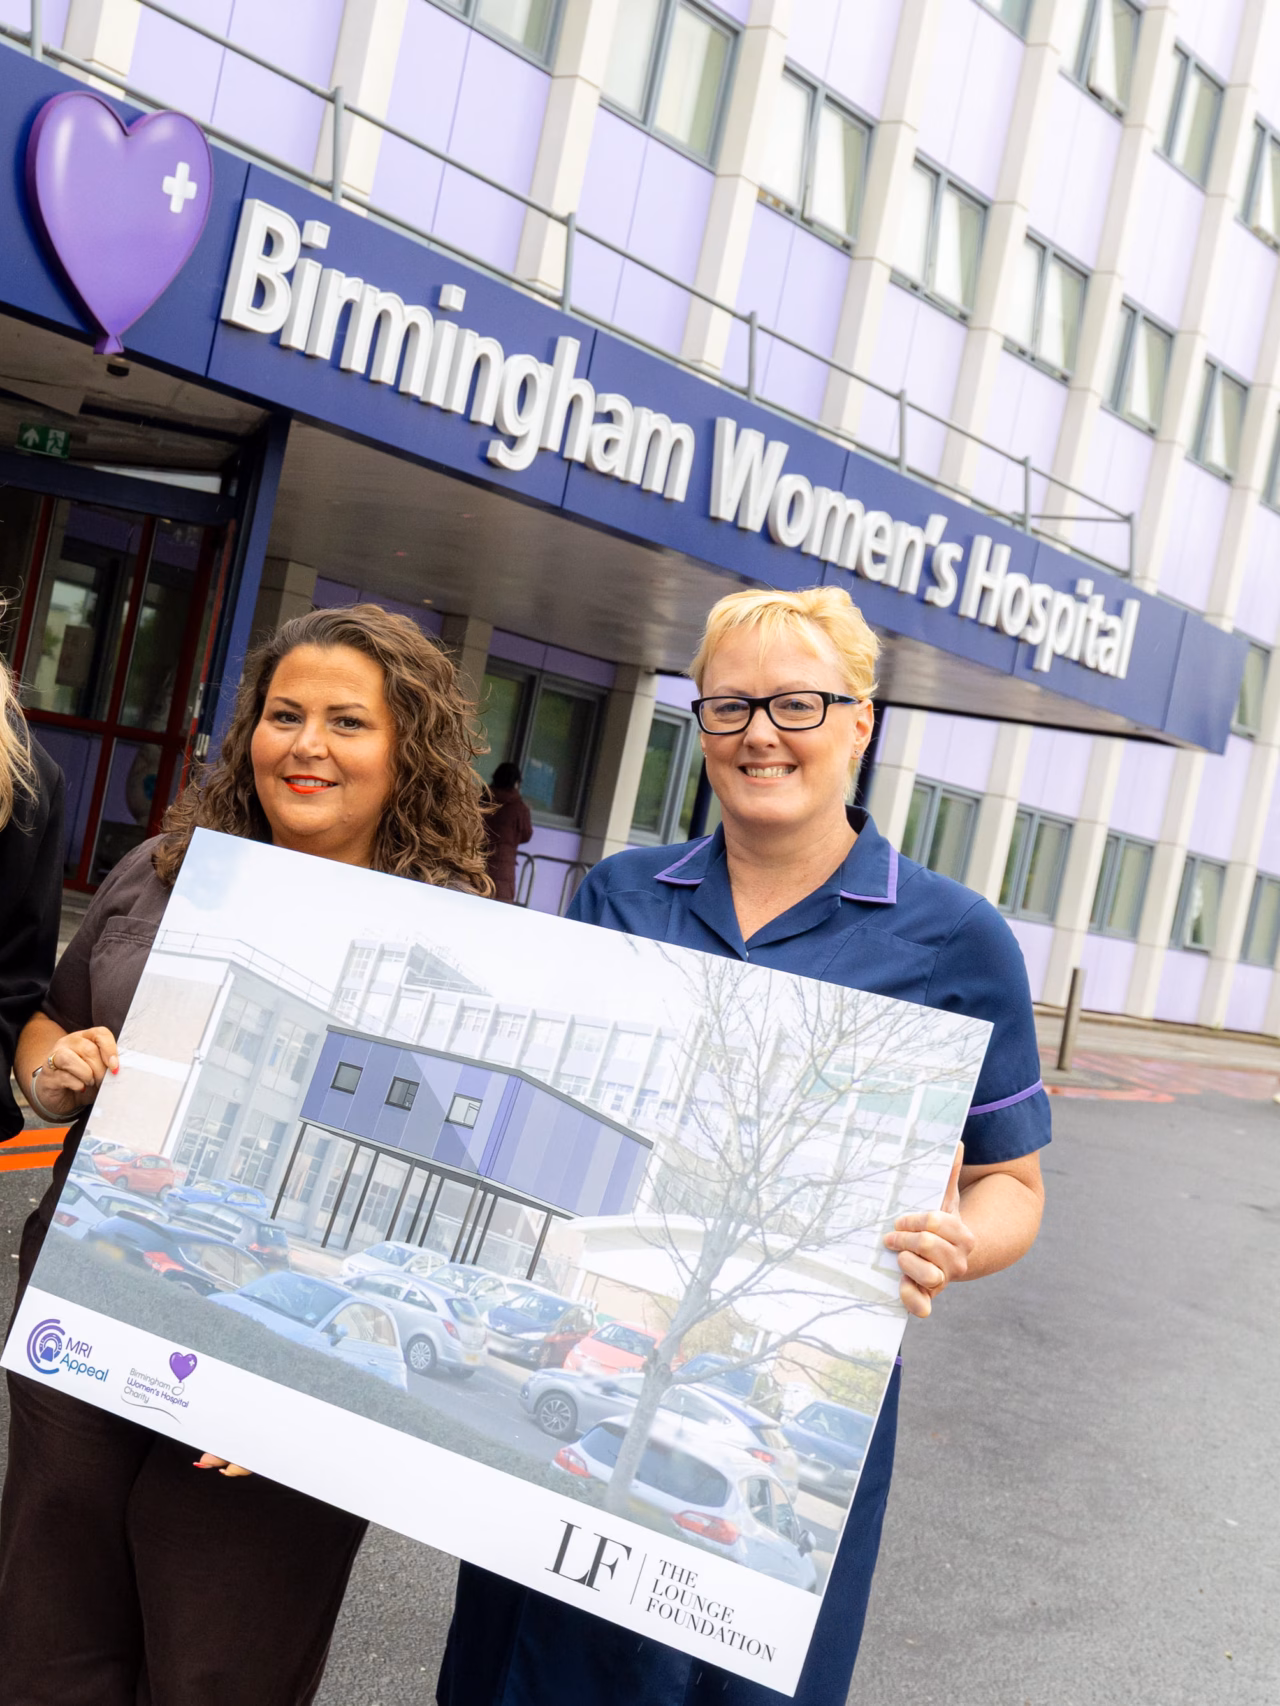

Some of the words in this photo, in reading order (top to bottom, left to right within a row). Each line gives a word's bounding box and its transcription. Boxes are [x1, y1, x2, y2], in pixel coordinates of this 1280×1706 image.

[221, 198, 695, 502] Birmingham
[709, 417, 964, 608] Women's
[958, 535, 1141, 680] Hospital
[65, 1337, 93, 1358] MRI
[60, 1353, 109, 1382] Appeal
[129, 1367, 171, 1391] Birmingham
[123, 1385, 150, 1404] Charity
[126, 1376, 160, 1397] Women's
[160, 1390, 189, 1408] Hospital
[544, 1519, 632, 1592] LF
[658, 1558, 699, 1589] THE
[650, 1578, 735, 1625] LOUNGE
[645, 1596, 777, 1663] FOUNDATION
